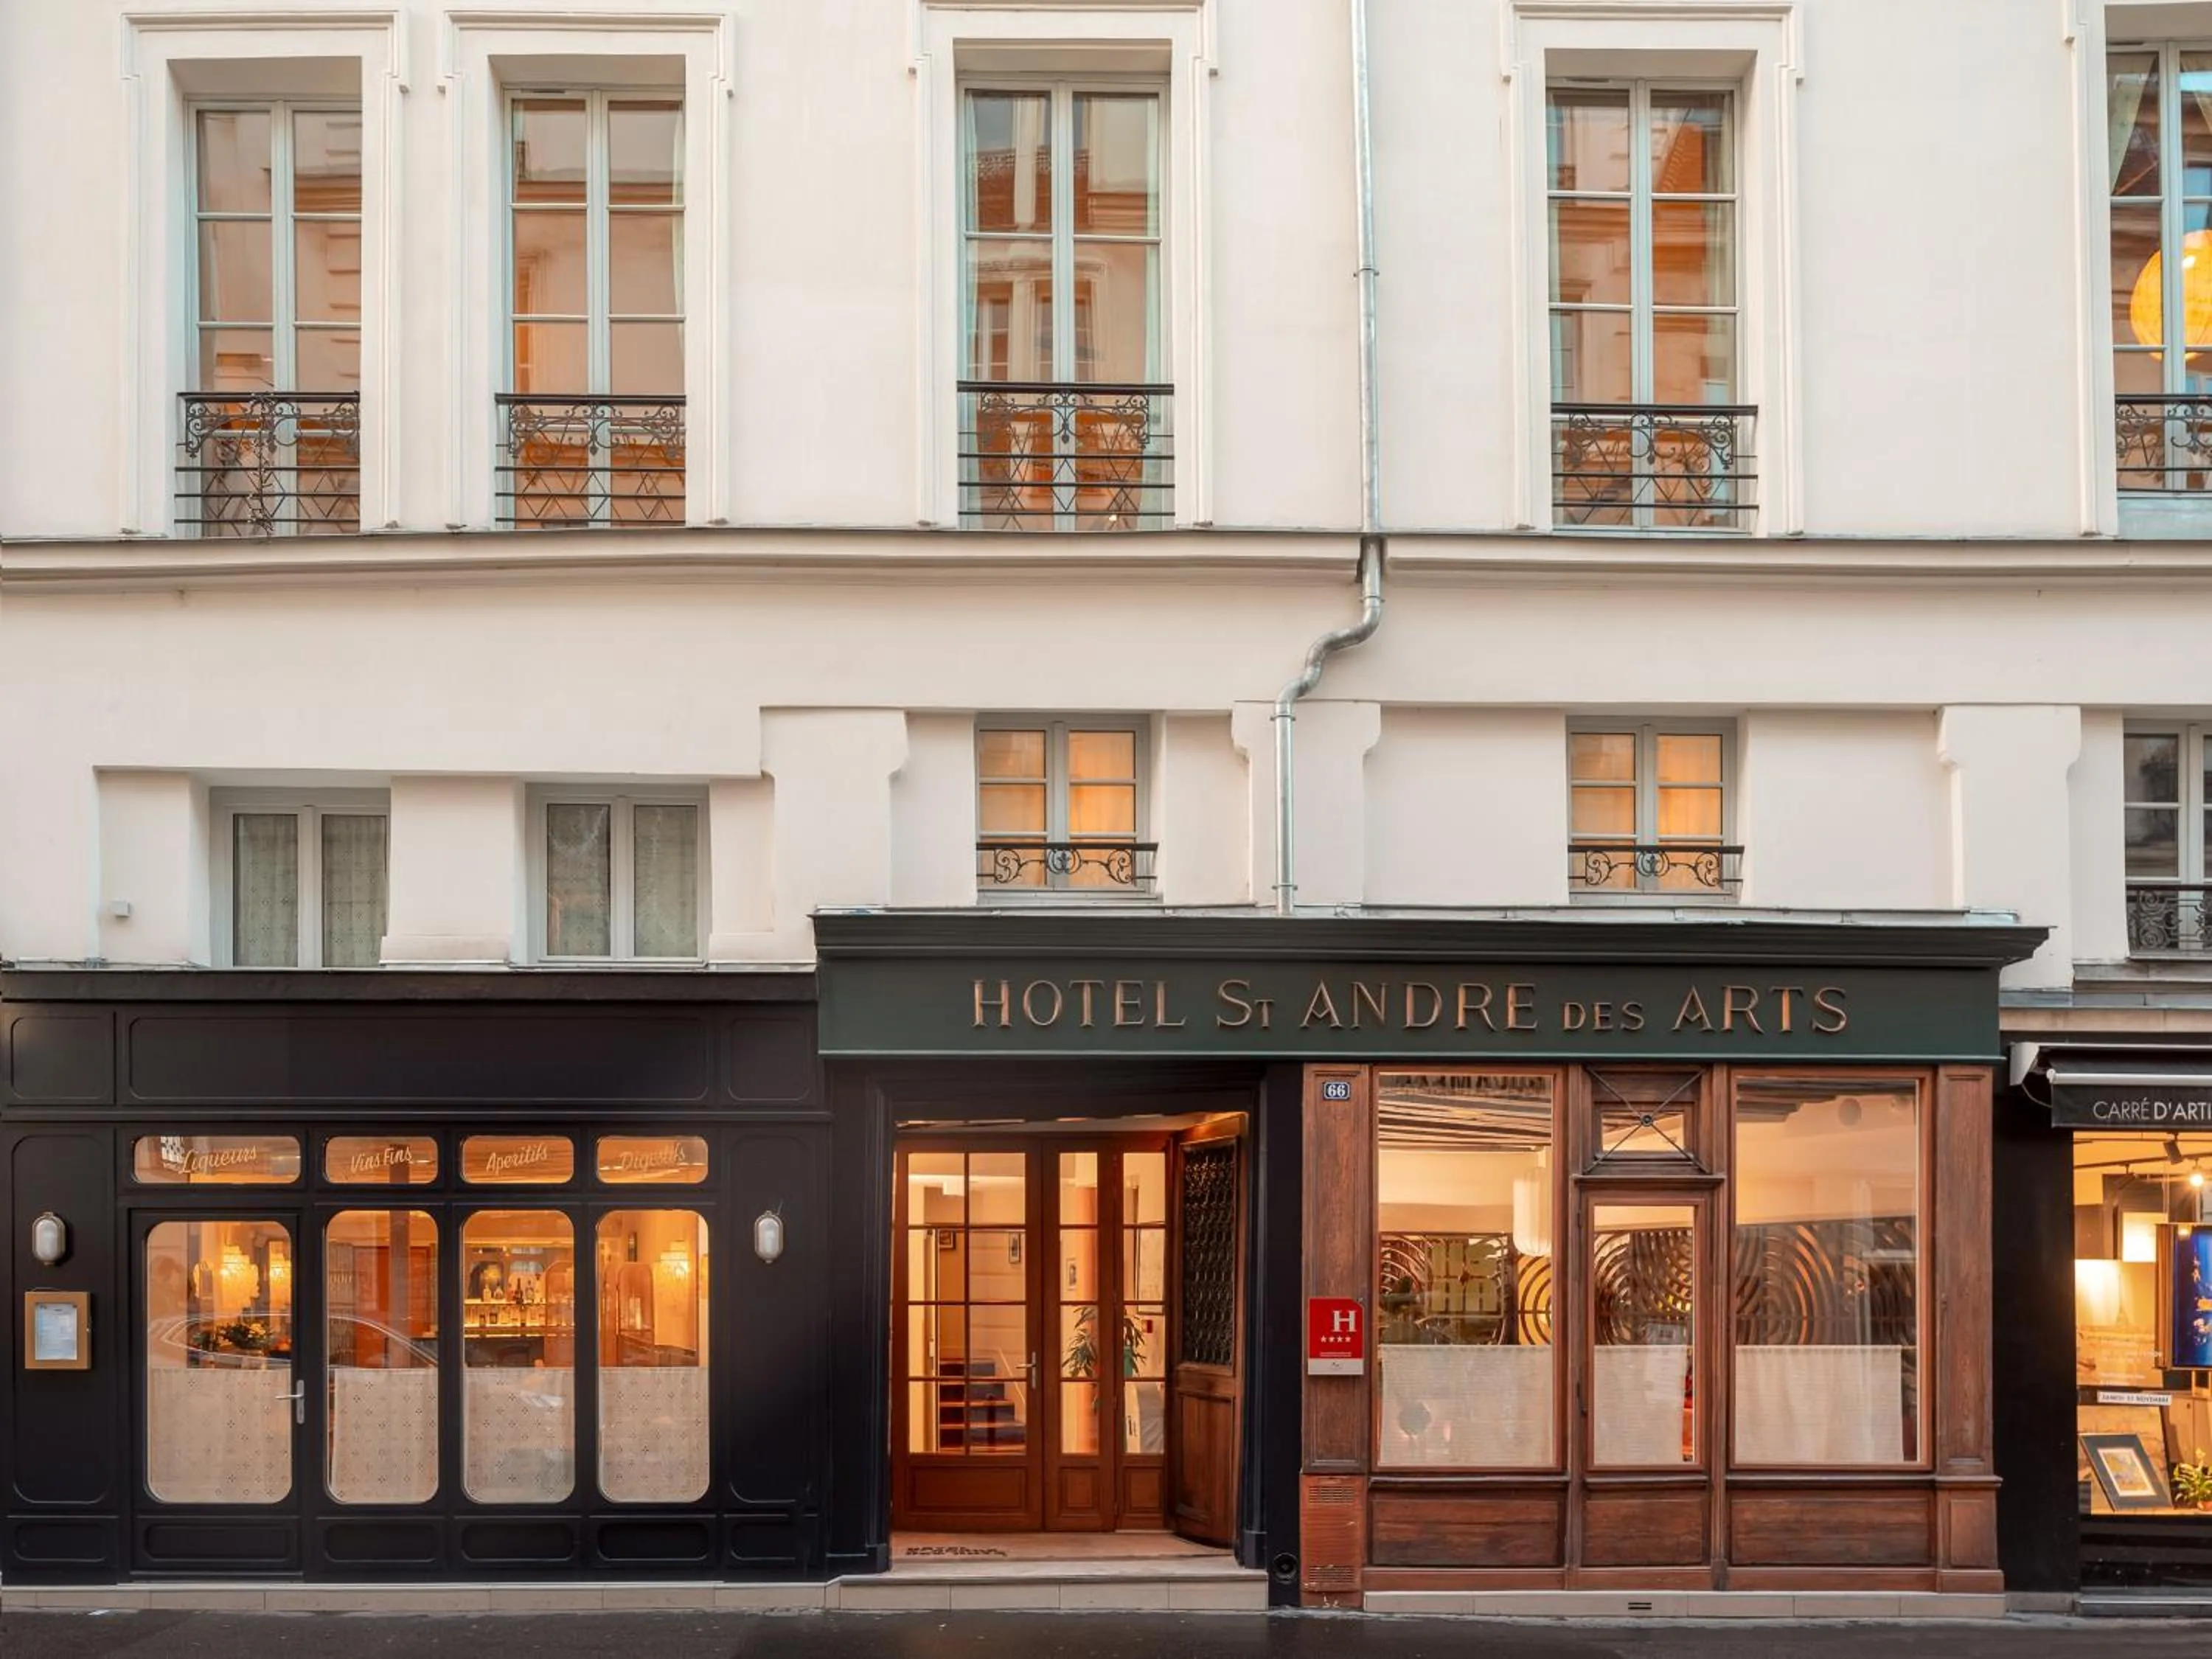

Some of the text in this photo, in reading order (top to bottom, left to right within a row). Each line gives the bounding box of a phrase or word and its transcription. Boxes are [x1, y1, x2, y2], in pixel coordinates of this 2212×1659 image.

[972, 979, 1187, 1028] HOTEL
[1299, 979, 1538, 1031] ANDRE
[1562, 1001, 1645, 1032] DES
[1672, 984, 1847, 1034] ARTS
[1328, 1084, 1346, 1097] 66
[2093, 1097, 2150, 1120] CARRÉ
[178, 1145, 257, 1175] Liqueurs
[350, 1146, 414, 1174] Vins Fins
[1332, 1310, 1357, 1332] H
